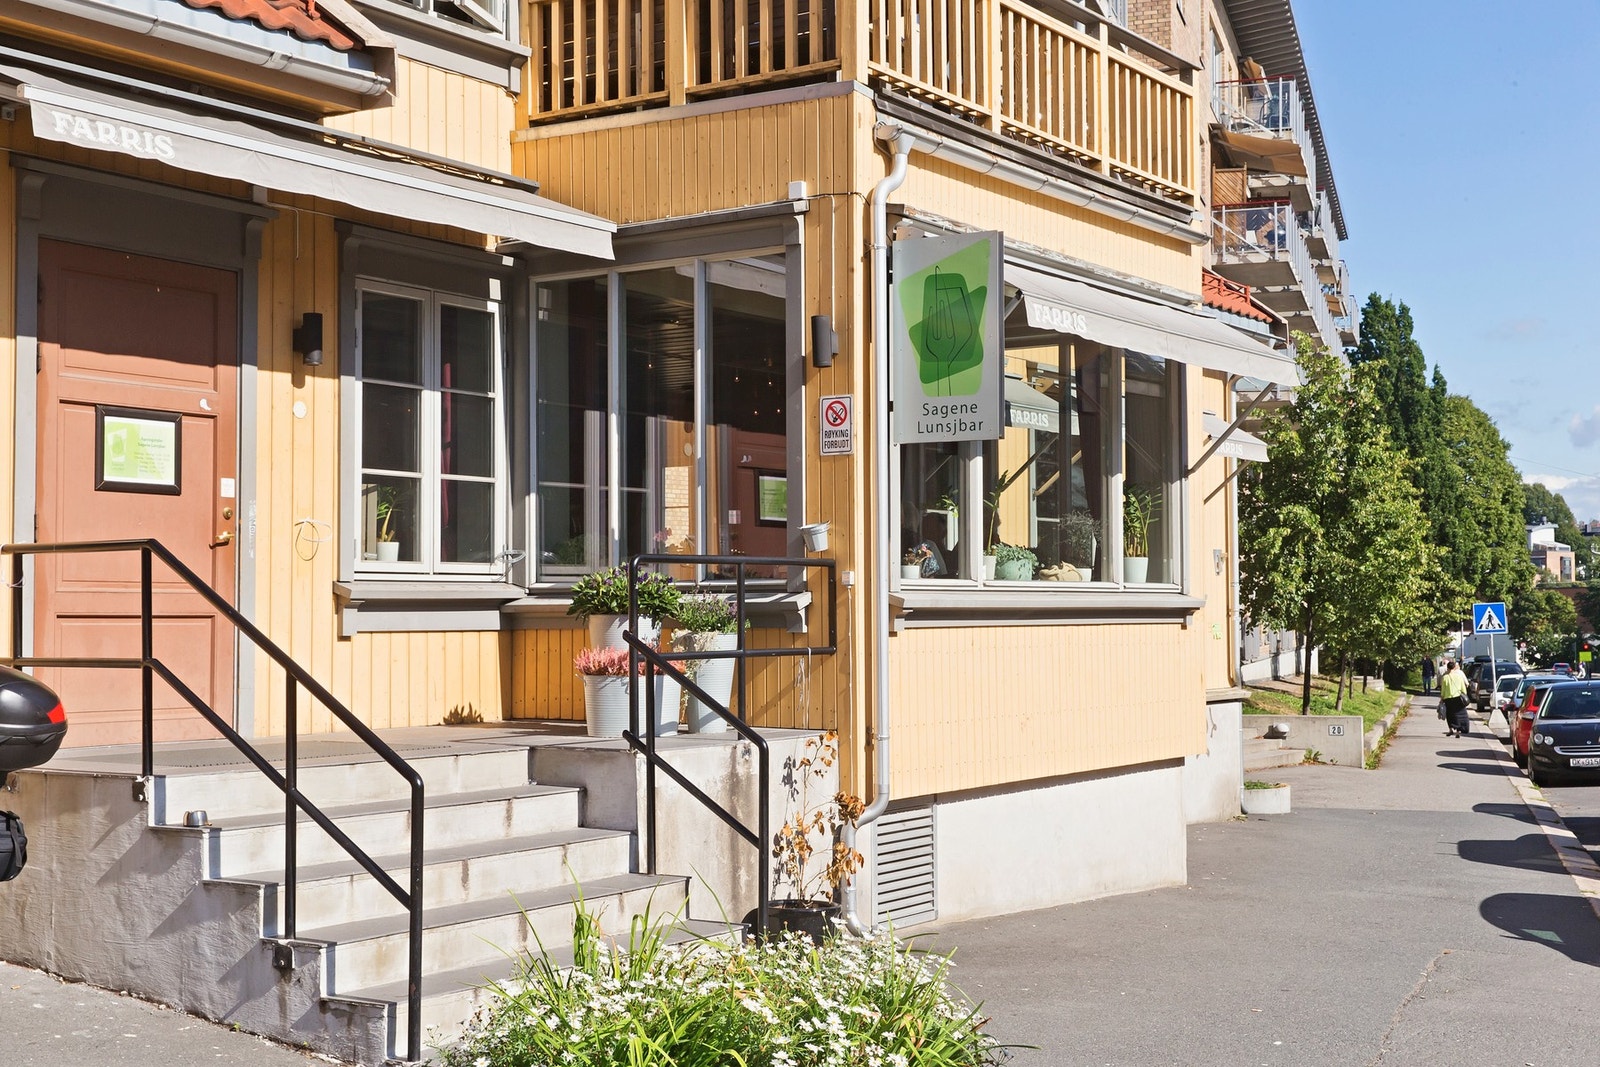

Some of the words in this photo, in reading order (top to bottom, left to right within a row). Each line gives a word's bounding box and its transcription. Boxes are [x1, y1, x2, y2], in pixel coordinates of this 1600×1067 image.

[50, 110, 176, 160] FARRIS
[1033, 303, 1088, 333] FARRIS
[922, 402, 978, 419] Sagene
[1010, 409, 1049, 428] FARRIS
[824, 429, 849, 439] RØYKING
[917, 418, 984, 436] Lunsjbar
[824, 439, 849, 450] FORBUDT
